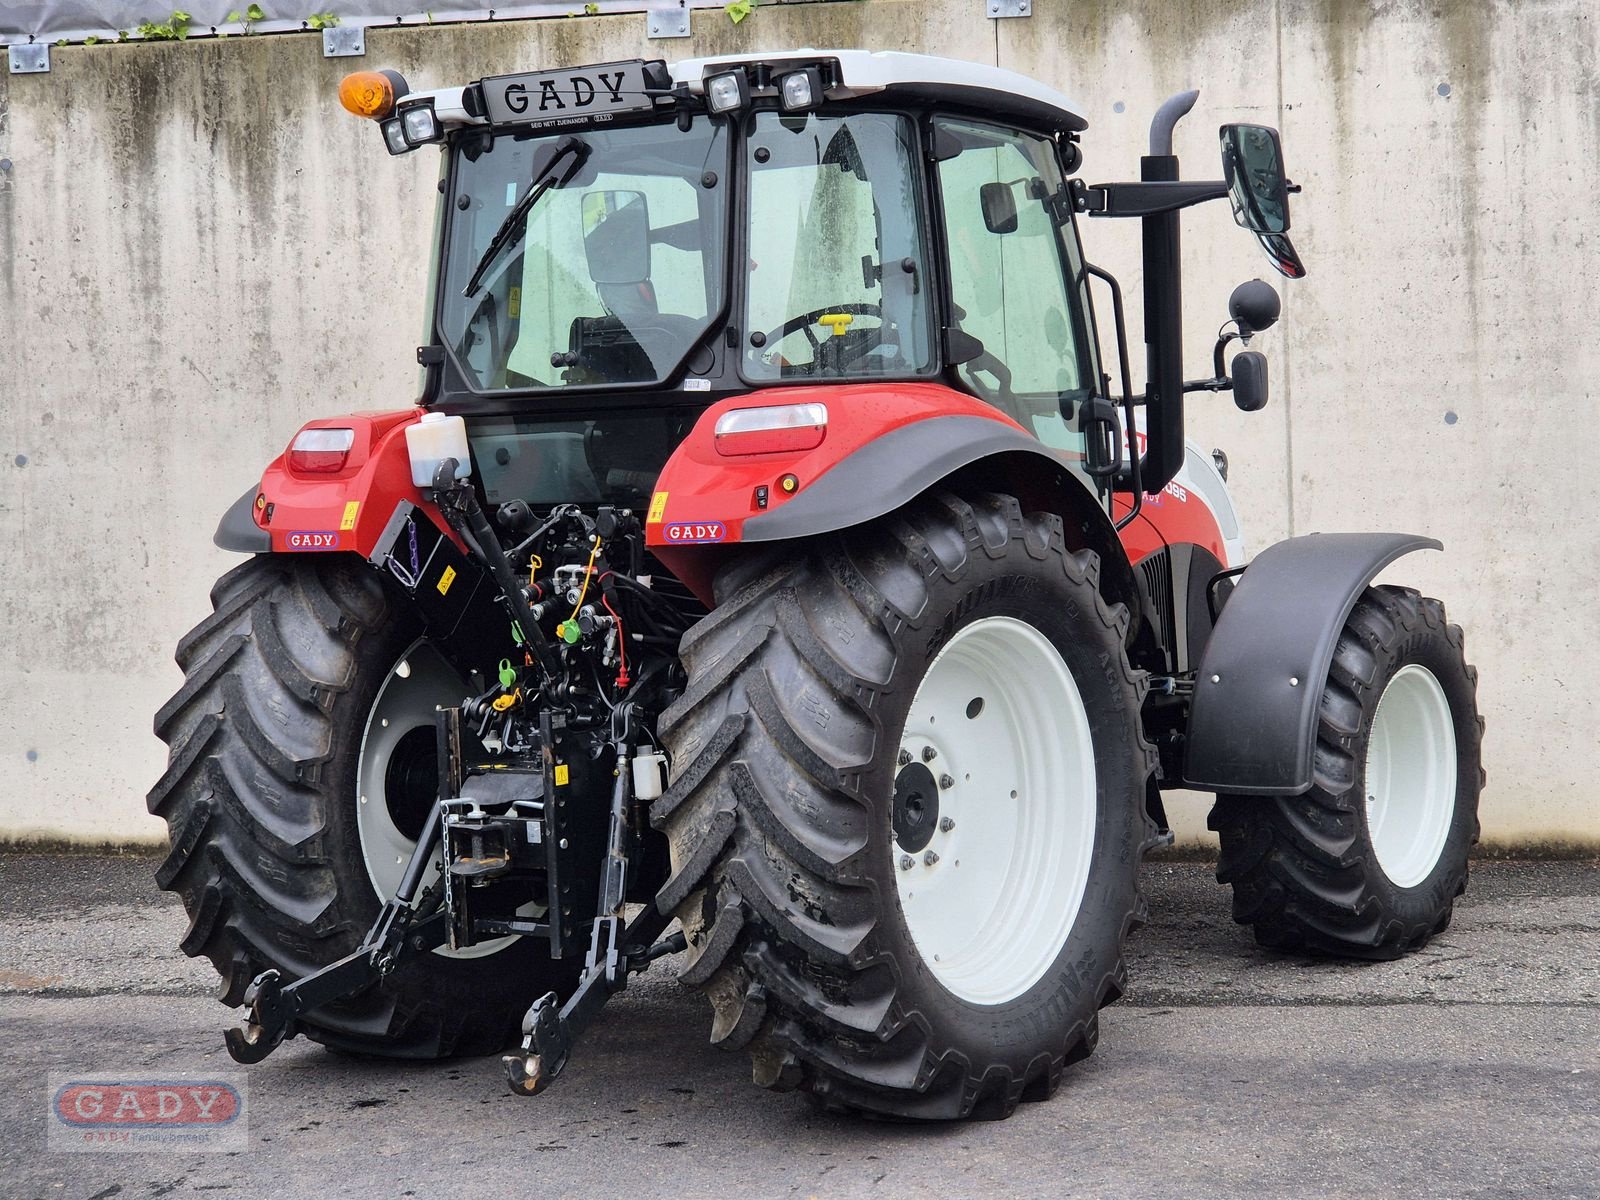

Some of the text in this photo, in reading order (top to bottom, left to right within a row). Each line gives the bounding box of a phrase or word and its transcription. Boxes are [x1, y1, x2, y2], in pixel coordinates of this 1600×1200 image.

[504, 72, 625, 114] GADY
[557, 116, 589, 126] ZUEINANDER
[1162, 482, 1187, 503] 095
[669, 525, 719, 539] GADY
[291, 534, 333, 546] GADY
